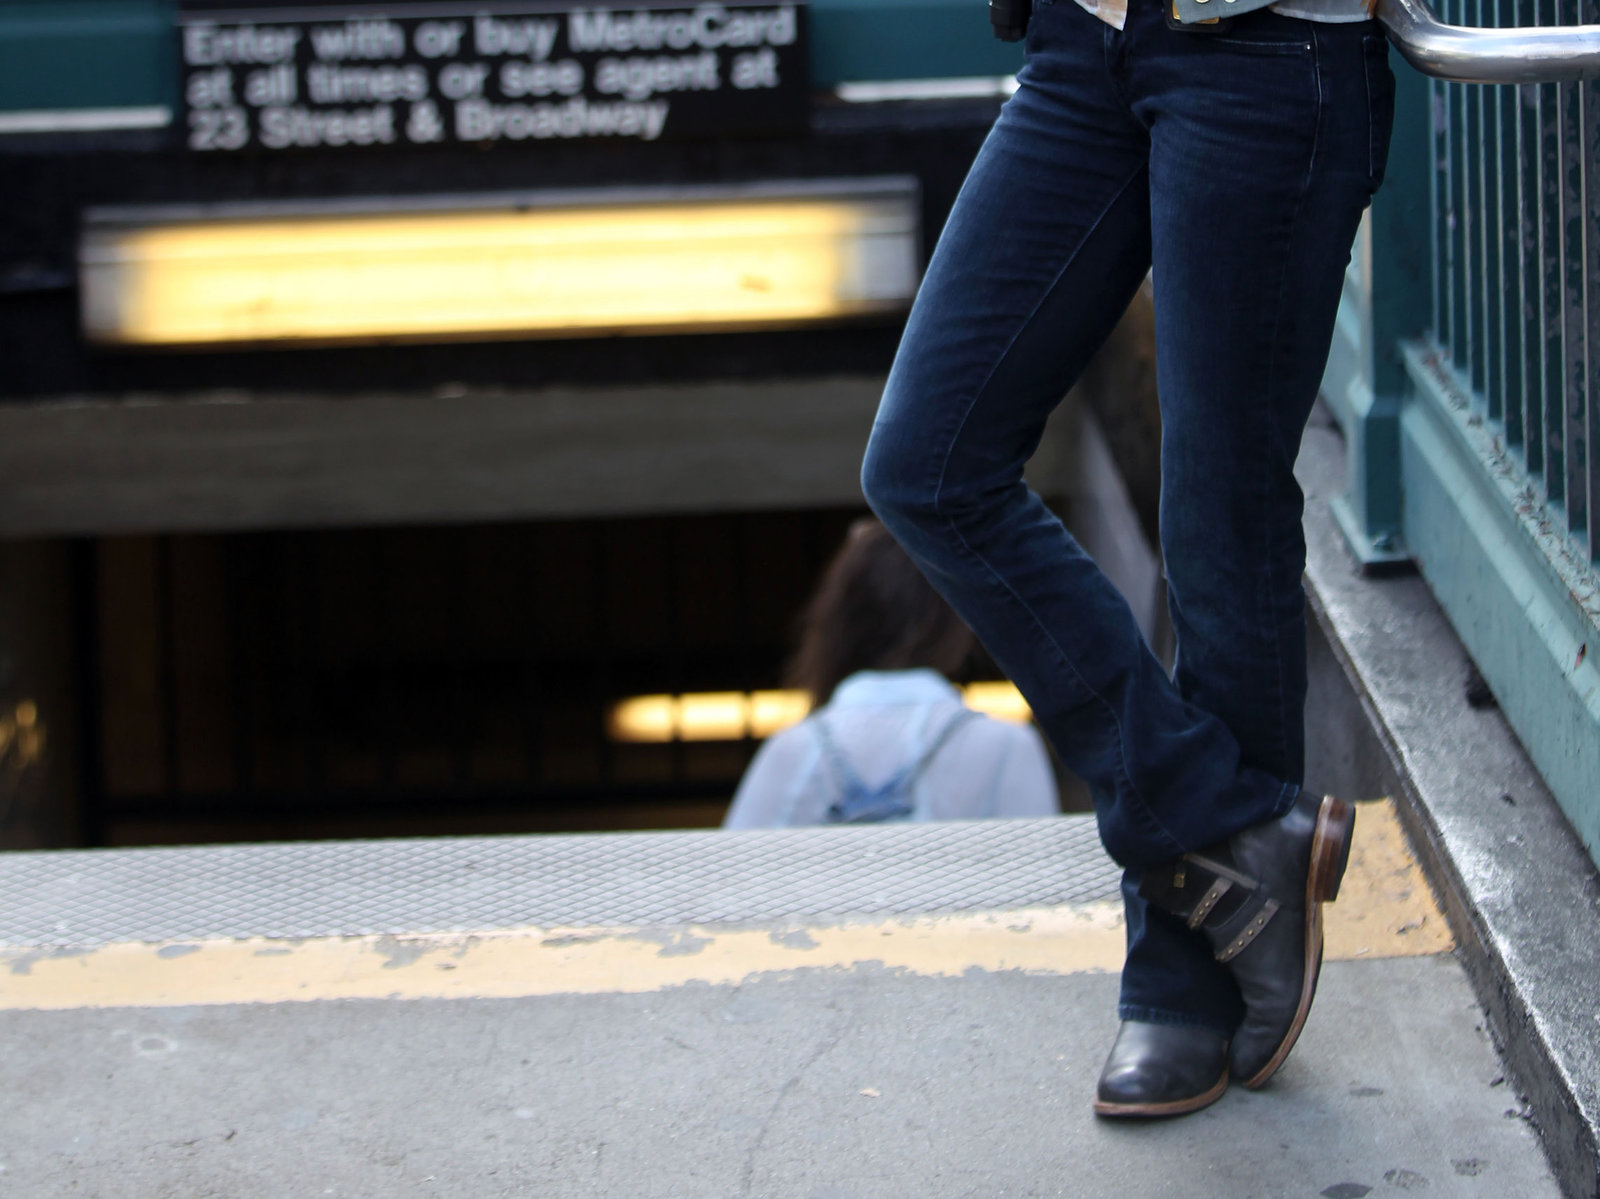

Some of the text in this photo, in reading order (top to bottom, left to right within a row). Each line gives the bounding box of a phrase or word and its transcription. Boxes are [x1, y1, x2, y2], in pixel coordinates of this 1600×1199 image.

[183, 4, 796, 65] Enter with or buy MetroCard
[187, 50, 778, 107] at all times or see agent at
[188, 98, 669, 150] 23 Street & Broadway
